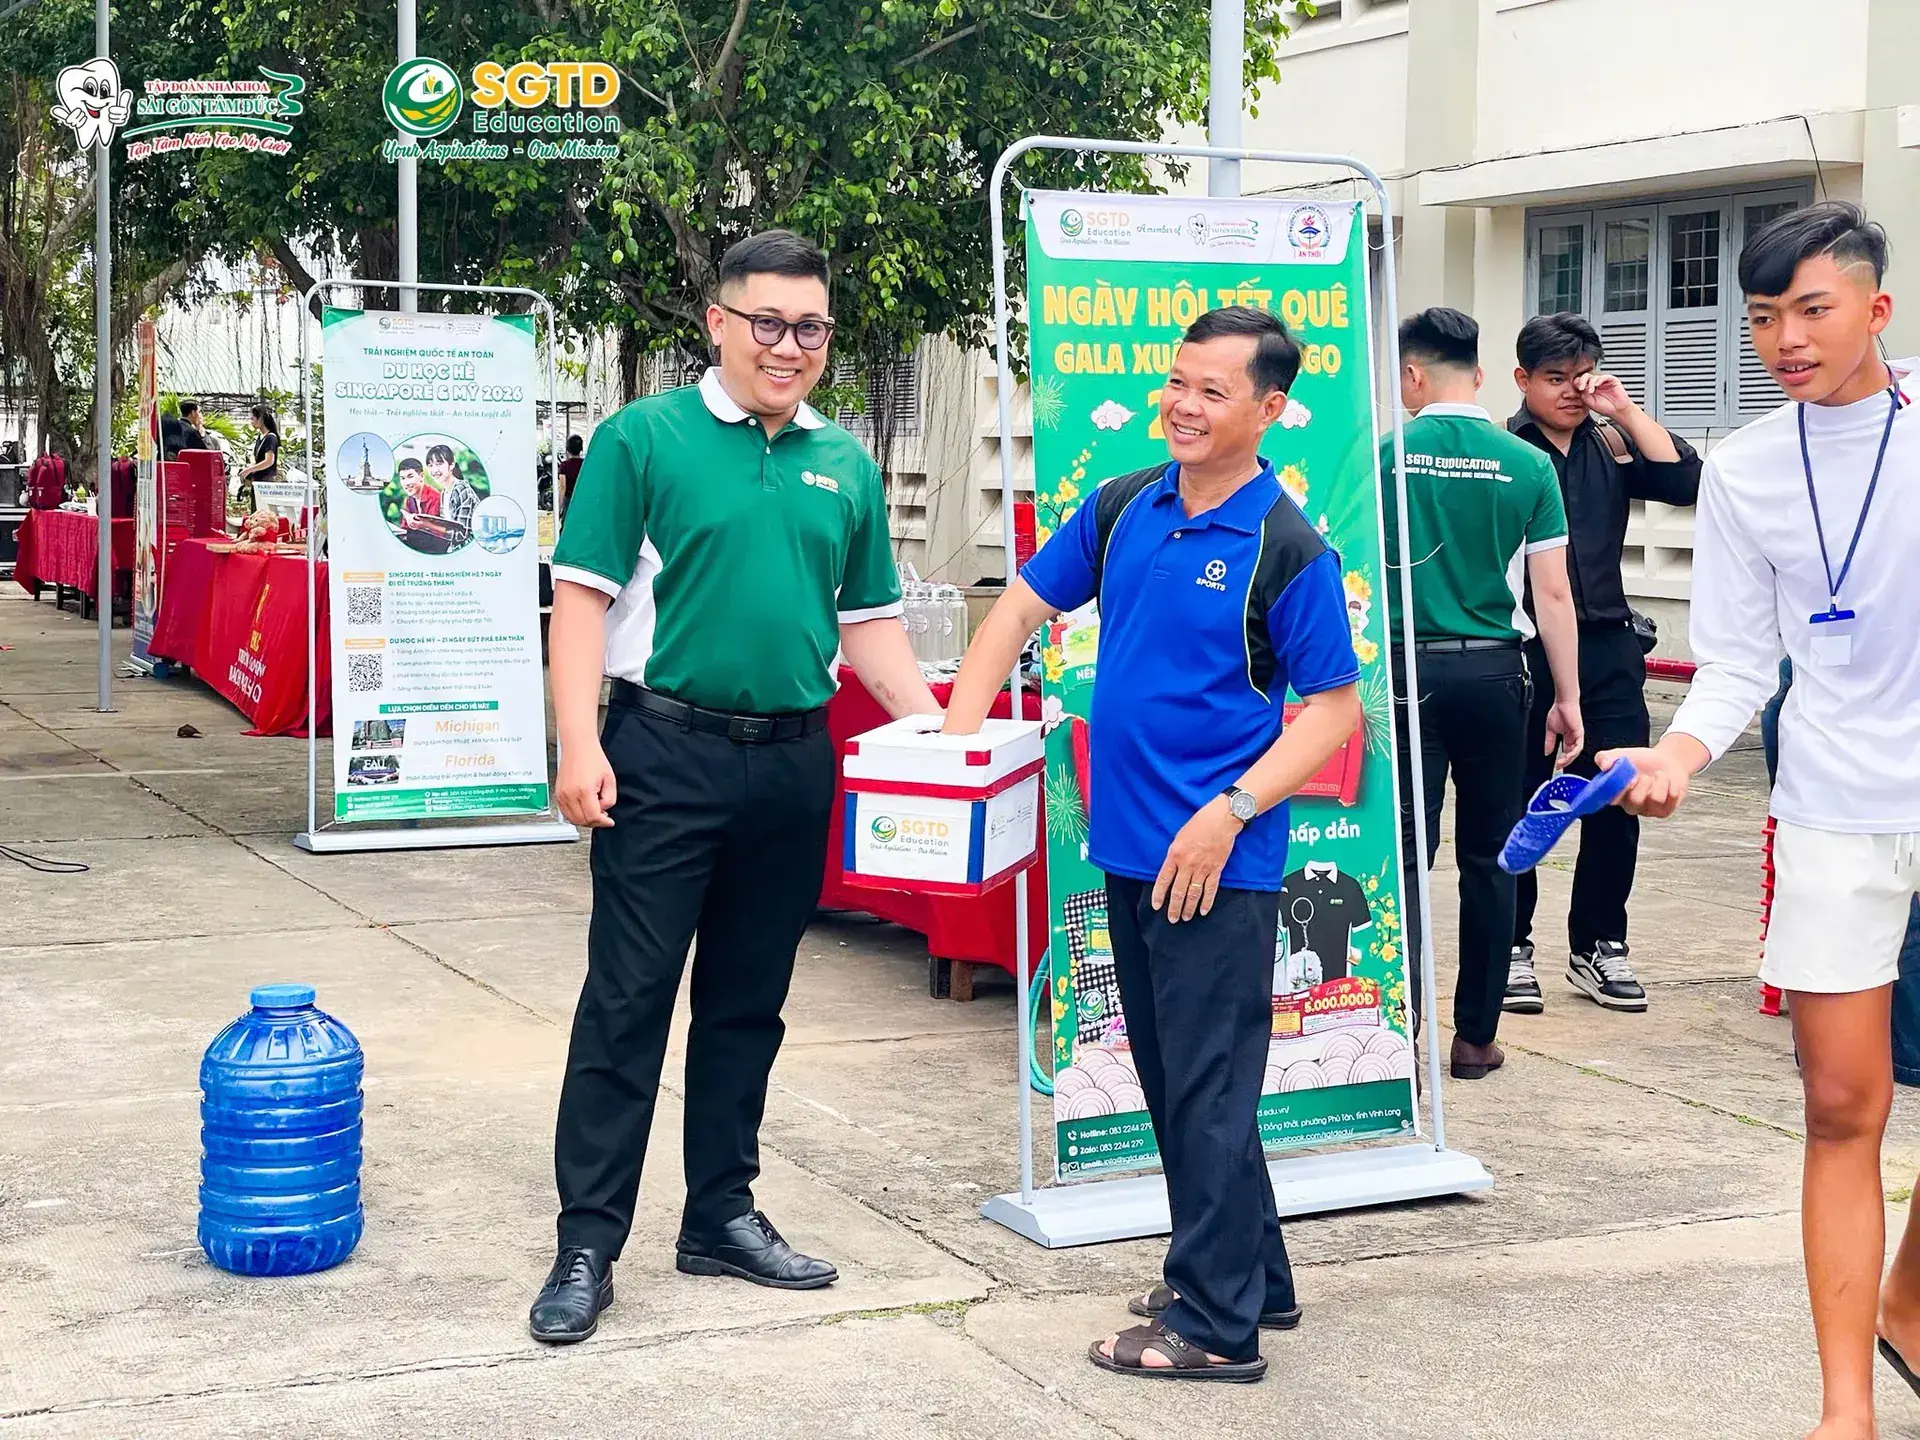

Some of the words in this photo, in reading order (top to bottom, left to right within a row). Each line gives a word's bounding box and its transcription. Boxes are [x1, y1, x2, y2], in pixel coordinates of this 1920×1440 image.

[1086, 213, 1130, 226] SGTD
[1088, 228, 1131, 237] Education
[1147, 225, 1173, 234] member
[1174, 225, 1181, 236] of
[1043, 279, 1138, 327] NGÀY
[1148, 280, 1208, 332] HỘI
[1281, 282, 1349, 329] QUÊ
[384, 347, 417, 359] NGHIỆM
[420, 346, 444, 358] QUỐC
[447, 347, 457, 358] TẾ
[457, 350, 469, 358] AN
[471, 348, 494, 358] TOÀN
[1054, 343, 1126, 375] GALA
[1132, 338, 1184, 374] XU
[1303, 345, 1341, 378] GỌ
[383, 363, 408, 379] DU
[411, 363, 449, 383] HỌC
[453, 361, 475, 381] HÈ
[335, 382, 434, 401] SINGAPORE
[437, 385, 449, 401] &
[453, 382, 480, 401] MỸ
[482, 386, 524, 402] 2026
[1405, 454, 1433, 466] SGTD
[1435, 457, 1500, 471] EUDUCATION
[1196, 577, 1226, 592] SPORTS
[436, 719, 500, 734] Michigan
[445, 754, 496, 768] Florida
[901, 820, 949, 837] SGTD
[1325, 817, 1360, 840] dẫn
[900, 835, 949, 847] Education
[1339, 983, 1352, 993] VIP
[1304, 992, 1374, 1013] 5.000.000Đ
[1257, 1106, 1290, 1117] d.edu.vn/
[1328, 1115, 1340, 1123] Phú
[1385, 1108, 1400, 1116] Long
[1080, 1129, 1108, 1139] Hotline:
[1109, 1126, 1121, 1135] 083
[1123, 1124, 1139, 1133] 2244
[1140, 1122, 1152, 1131] 279
[1080, 1146, 1099, 1155] Zalo:
[1100, 1143, 1112, 1152] 083
[1114, 1142, 1130, 1150] 2244
[1131, 1139, 1144, 1148] 279
